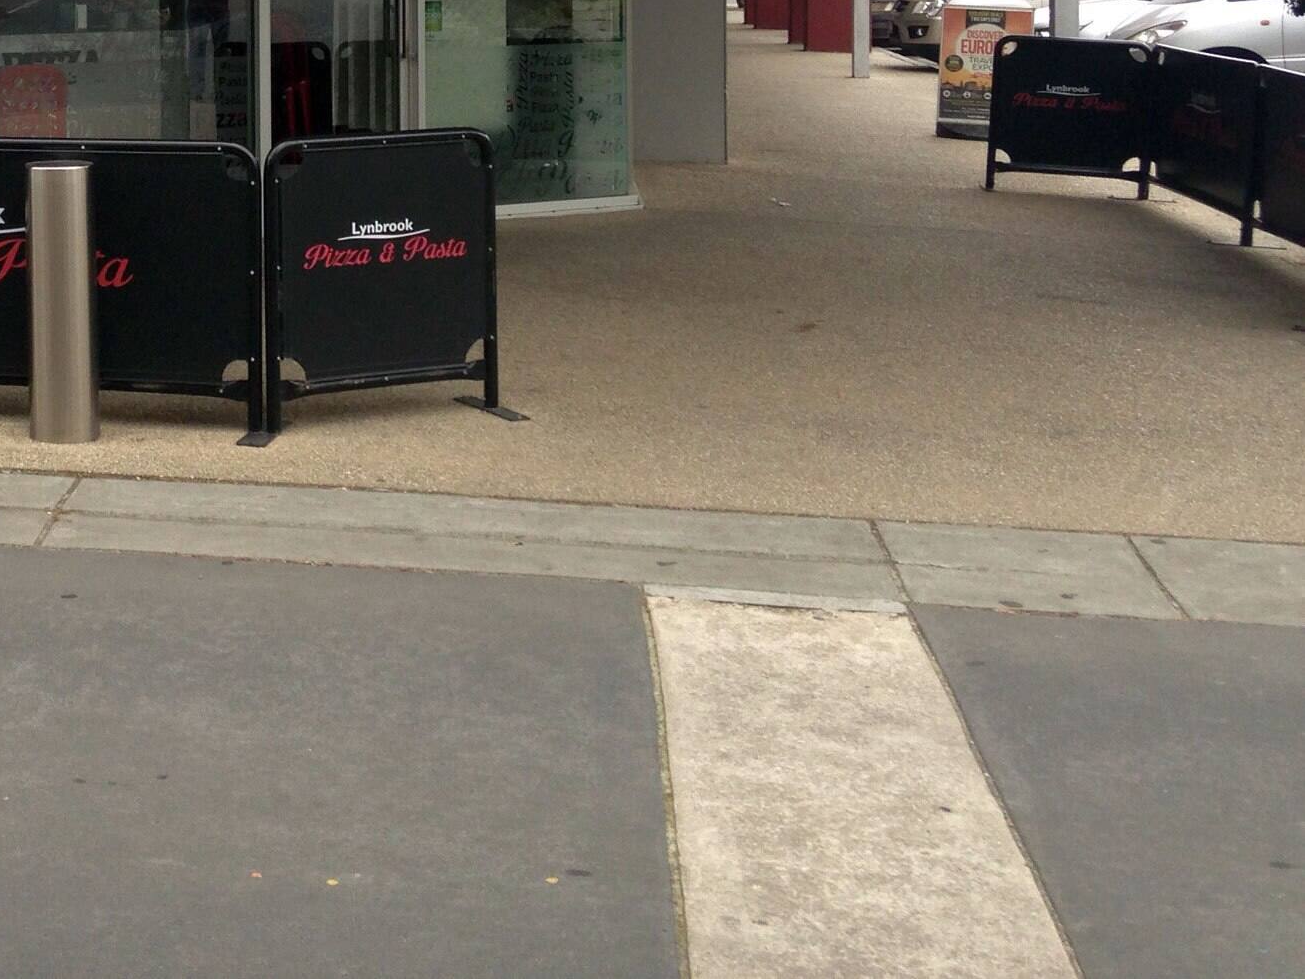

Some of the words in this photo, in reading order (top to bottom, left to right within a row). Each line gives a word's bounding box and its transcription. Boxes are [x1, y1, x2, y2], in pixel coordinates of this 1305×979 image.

[960, 38, 994, 55] EURO
[1045, 83, 1090, 95] Lynbrook
[350, 217, 414, 237] Lynbrook
[302, 242, 373, 271] Pizza
[378, 240, 396, 264] &
[401, 234, 468, 263] Pasta
